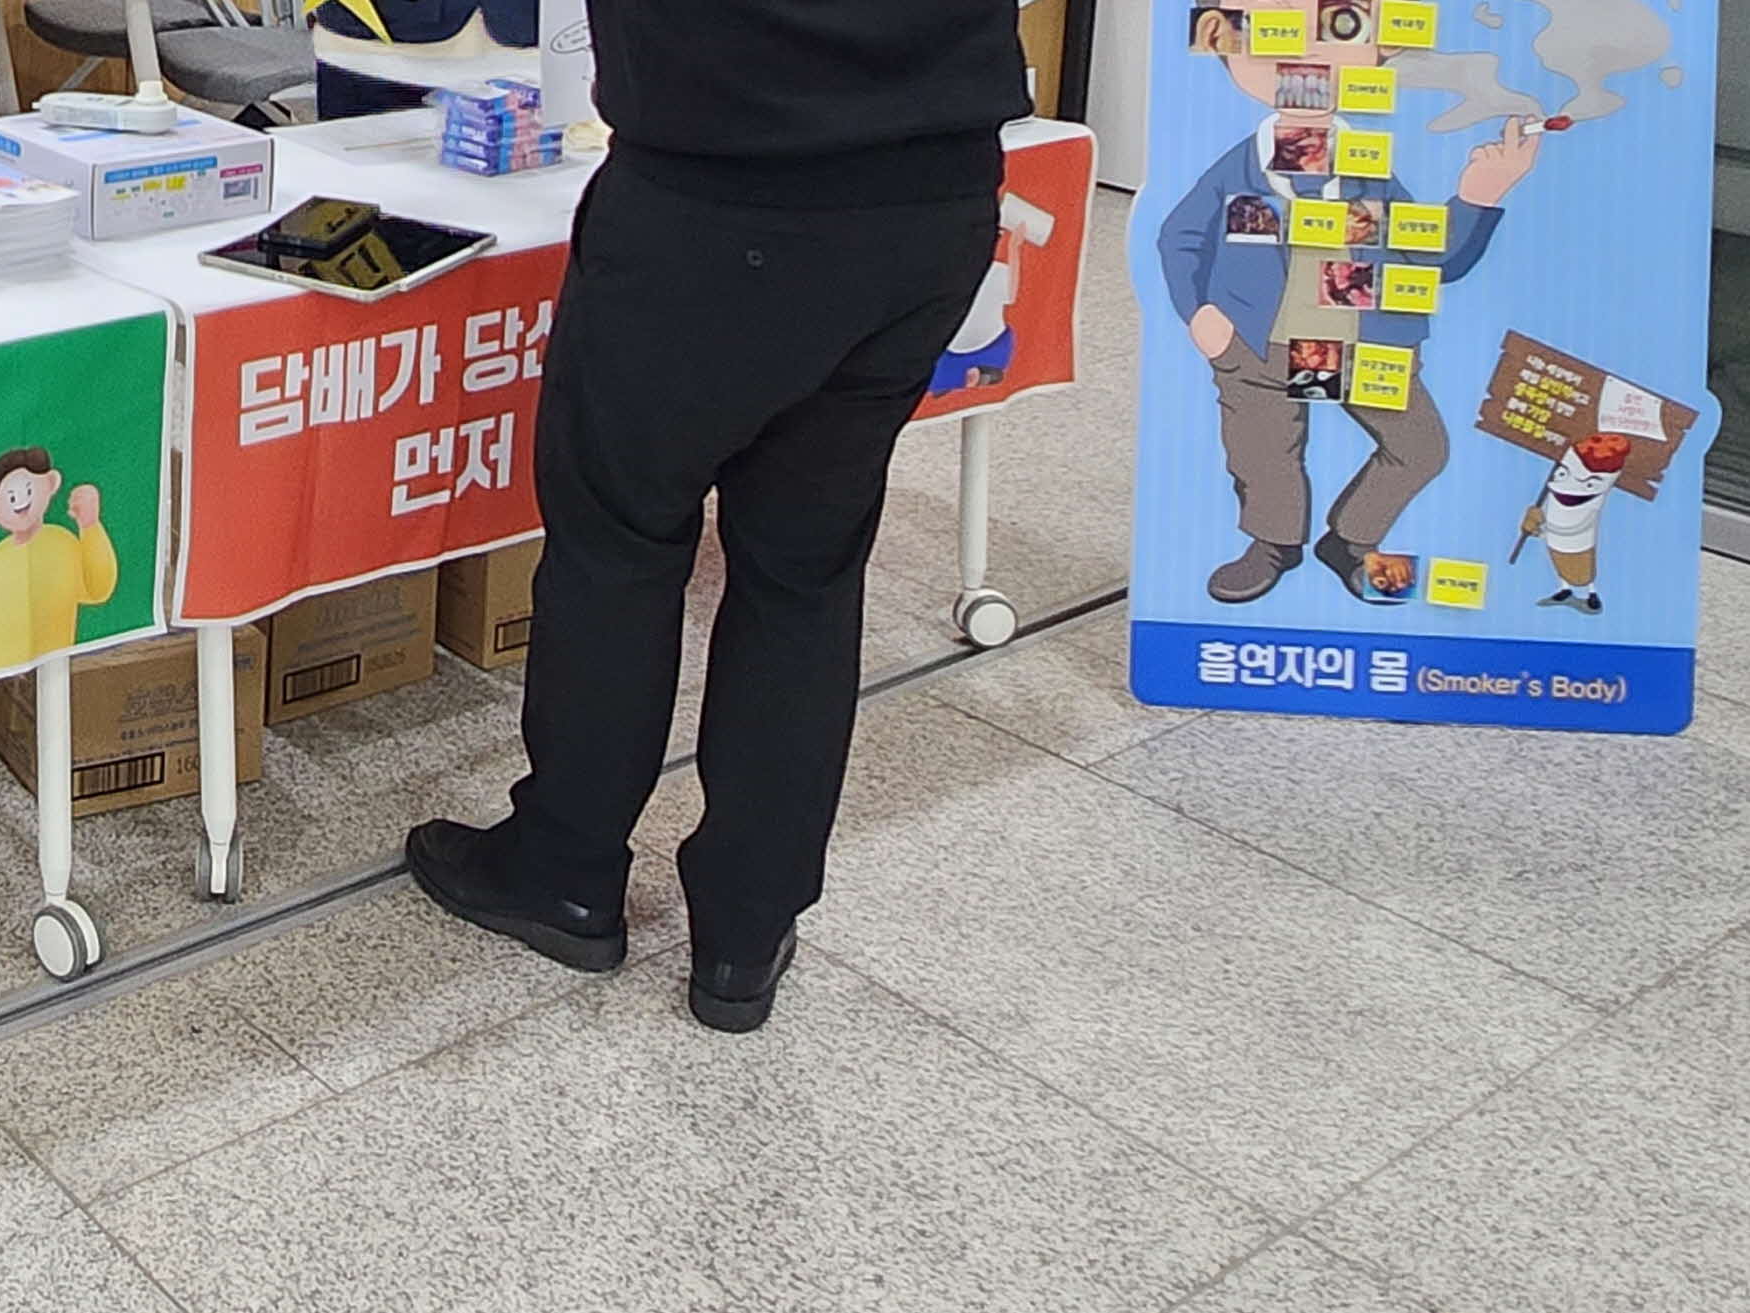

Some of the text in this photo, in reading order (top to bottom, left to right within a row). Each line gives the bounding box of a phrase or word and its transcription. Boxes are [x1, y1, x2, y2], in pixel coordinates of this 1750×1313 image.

[239, 324, 441, 447] 담배가
[390, 412, 515, 517] 먼저
[1197, 640, 1627, 704] 흡연자의 몸 (Smoker's Body)
